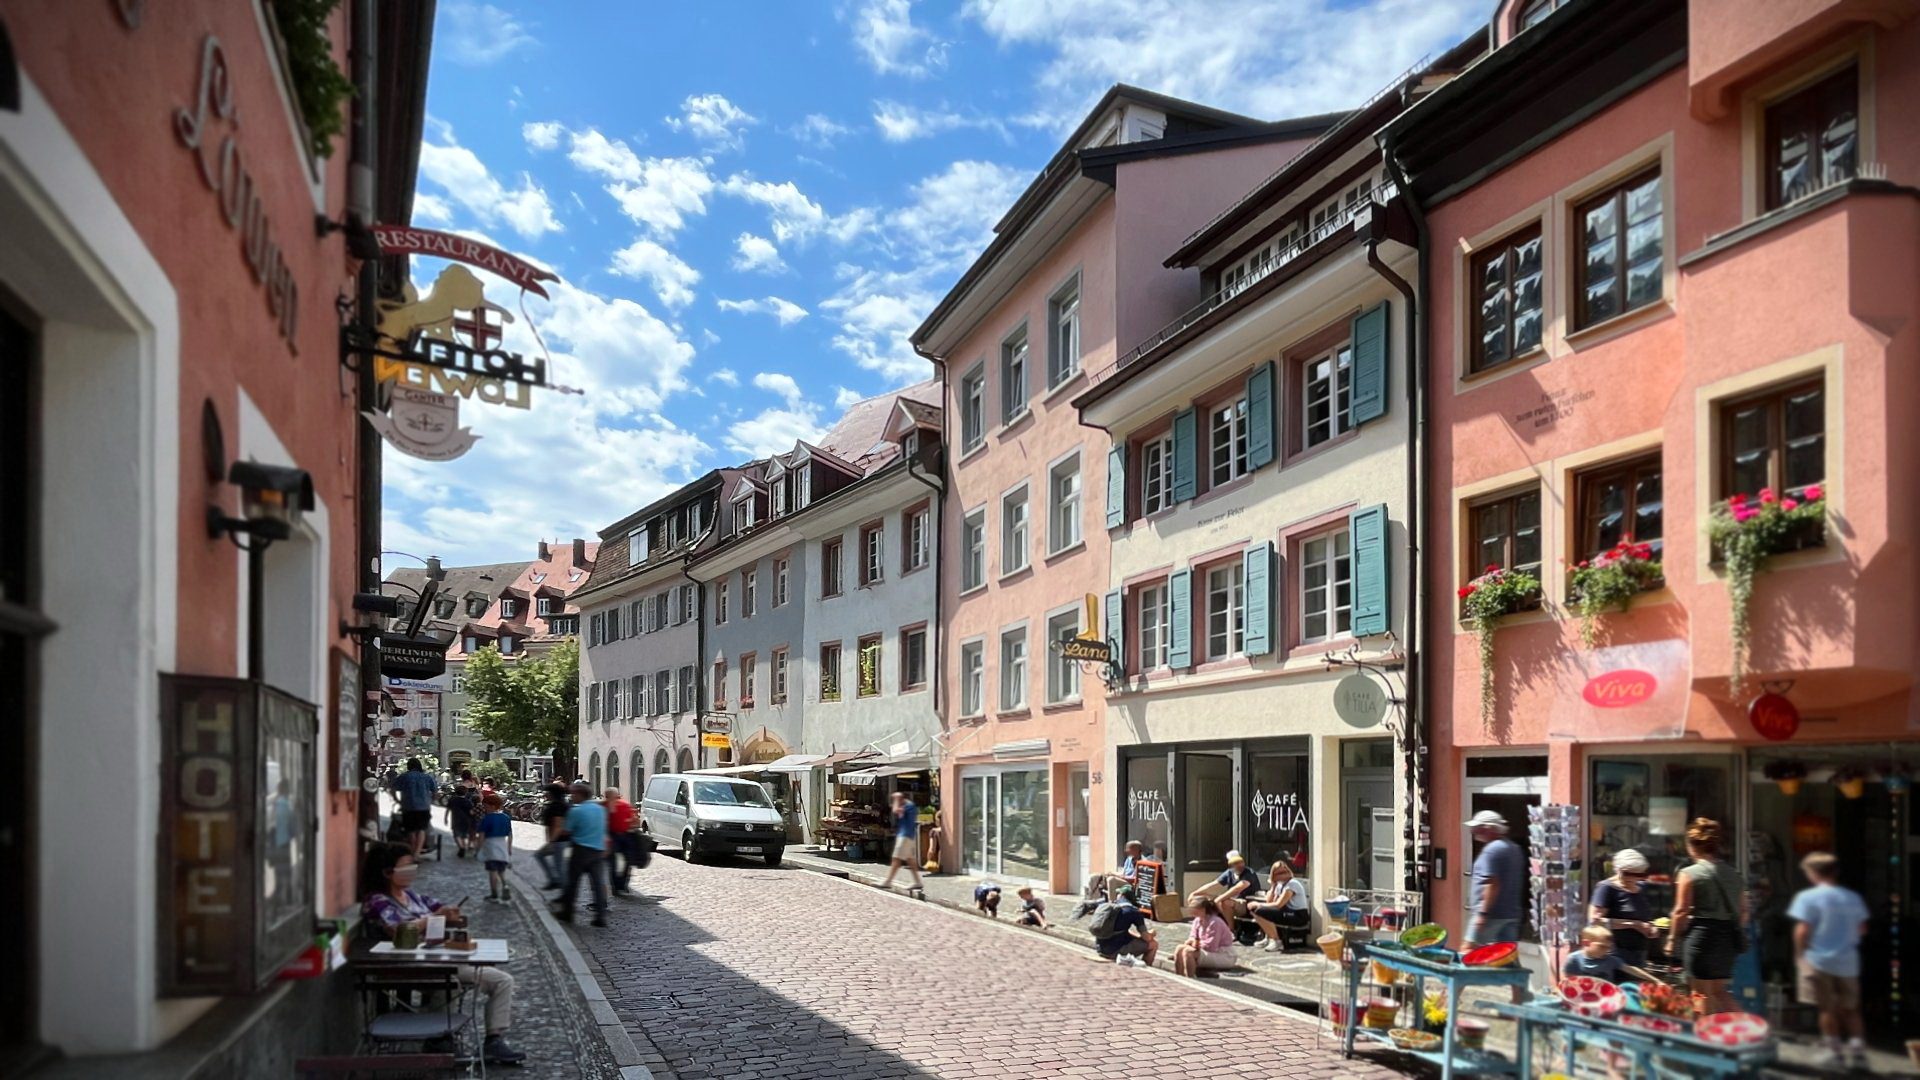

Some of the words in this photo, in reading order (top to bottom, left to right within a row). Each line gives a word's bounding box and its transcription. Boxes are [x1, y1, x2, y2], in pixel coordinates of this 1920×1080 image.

[374, 230, 537, 283] RESTAURANT
[380, 646, 443, 658] BERLINDEN
[384, 655, 430, 665] PASSAGE
[1064, 643, 1109, 661] Lang
[1594, 679, 1647, 699] Viva
[1352, 699, 1378, 714] TILIA
[1757, 704, 1793, 731] Viva
[1137, 789, 1159, 800] CAFÉ
[1266, 792, 1297, 804] CAFÉ
[1138, 801, 1169, 822] TILIA
[1267, 805, 1310, 832] TILIA
